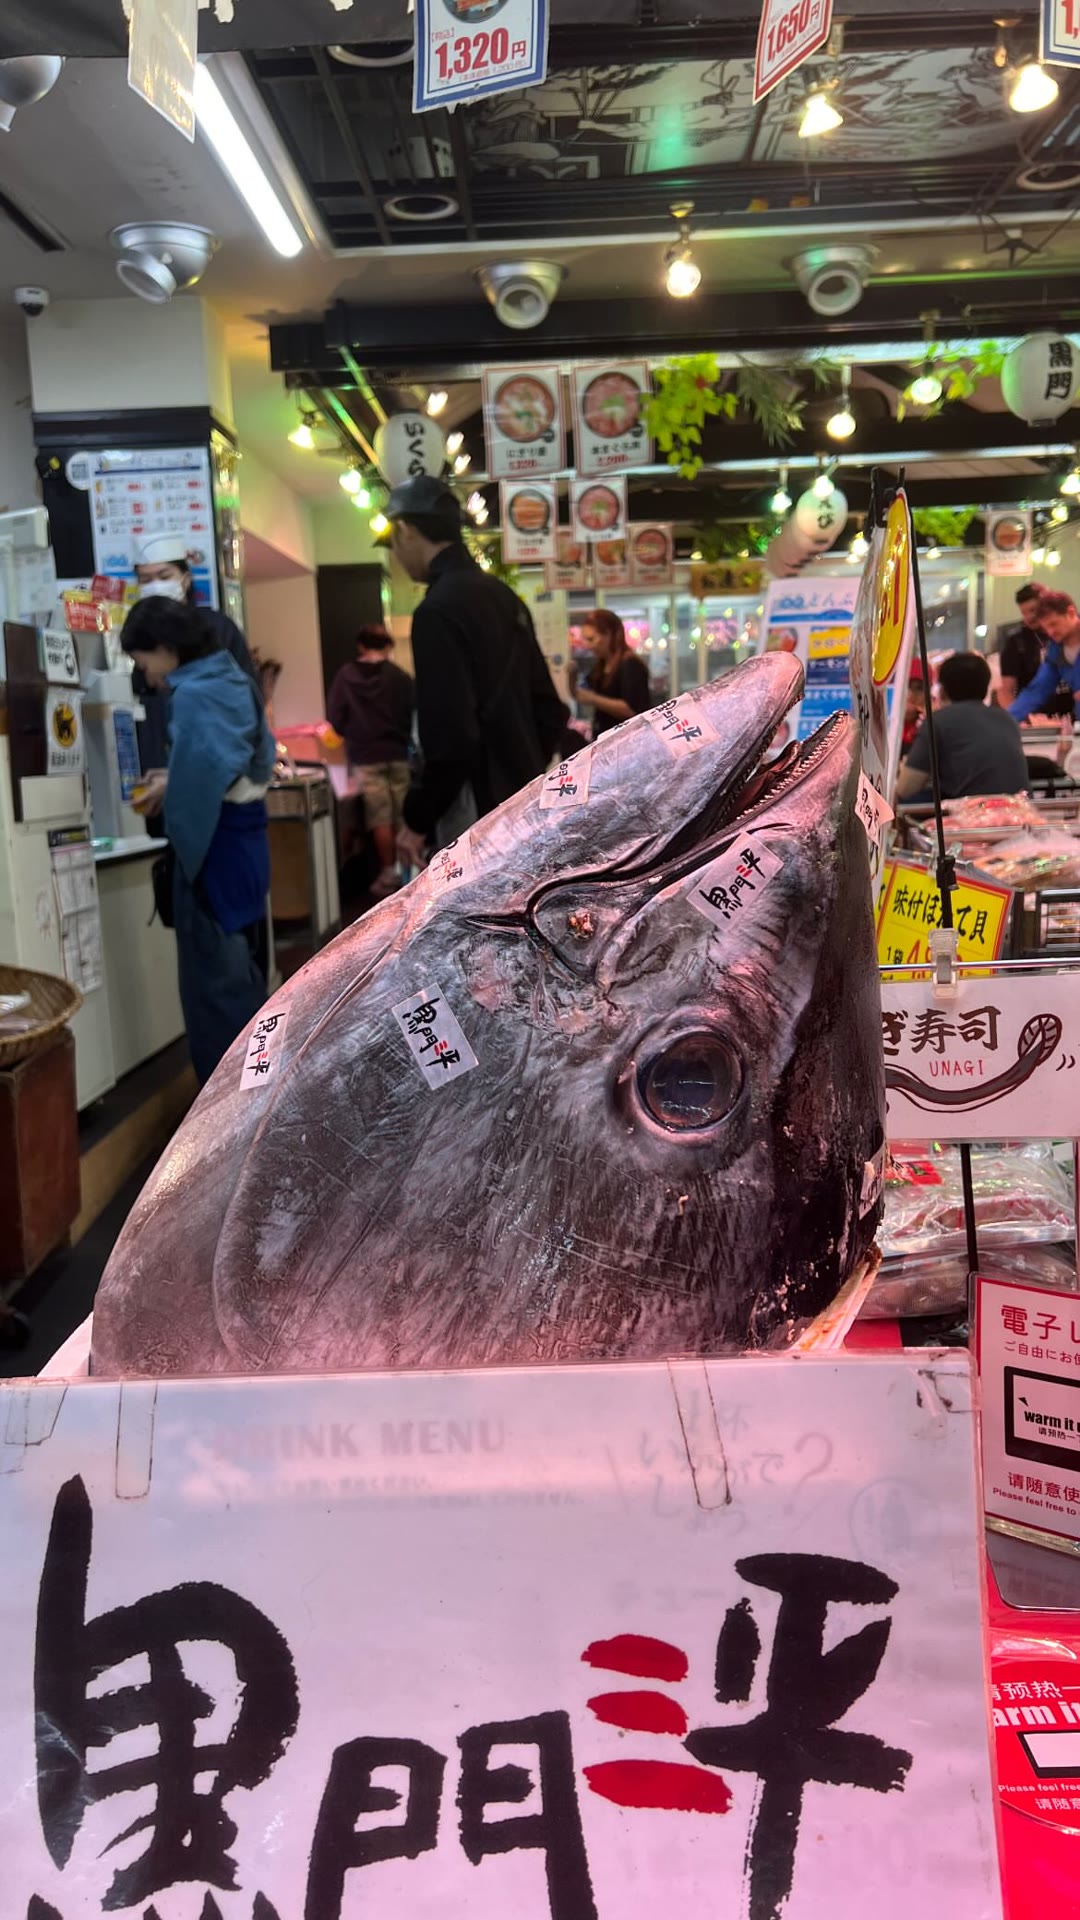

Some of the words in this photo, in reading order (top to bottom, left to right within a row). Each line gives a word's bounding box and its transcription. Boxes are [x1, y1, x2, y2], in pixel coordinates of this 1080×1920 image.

[434, 27, 527, 79] 1,320円
[893, 885, 988, 944] 味付ほて貝
[929, 1059, 984, 1077] UNAGI
[1024, 1410, 1061, 1429] warm
[1064, 1417, 1075, 1431] it
[380, 1417, 507, 1456] MENU
[993, 1487, 1023, 1502] Please
[1026, 1496, 1043, 1508] feel
[1046, 1501, 1064, 1512] free
[1067, 1507, 1077, 1516] to
[998, 1784, 1036, 1793] Please
[1037, 1783, 1059, 1792] feel
